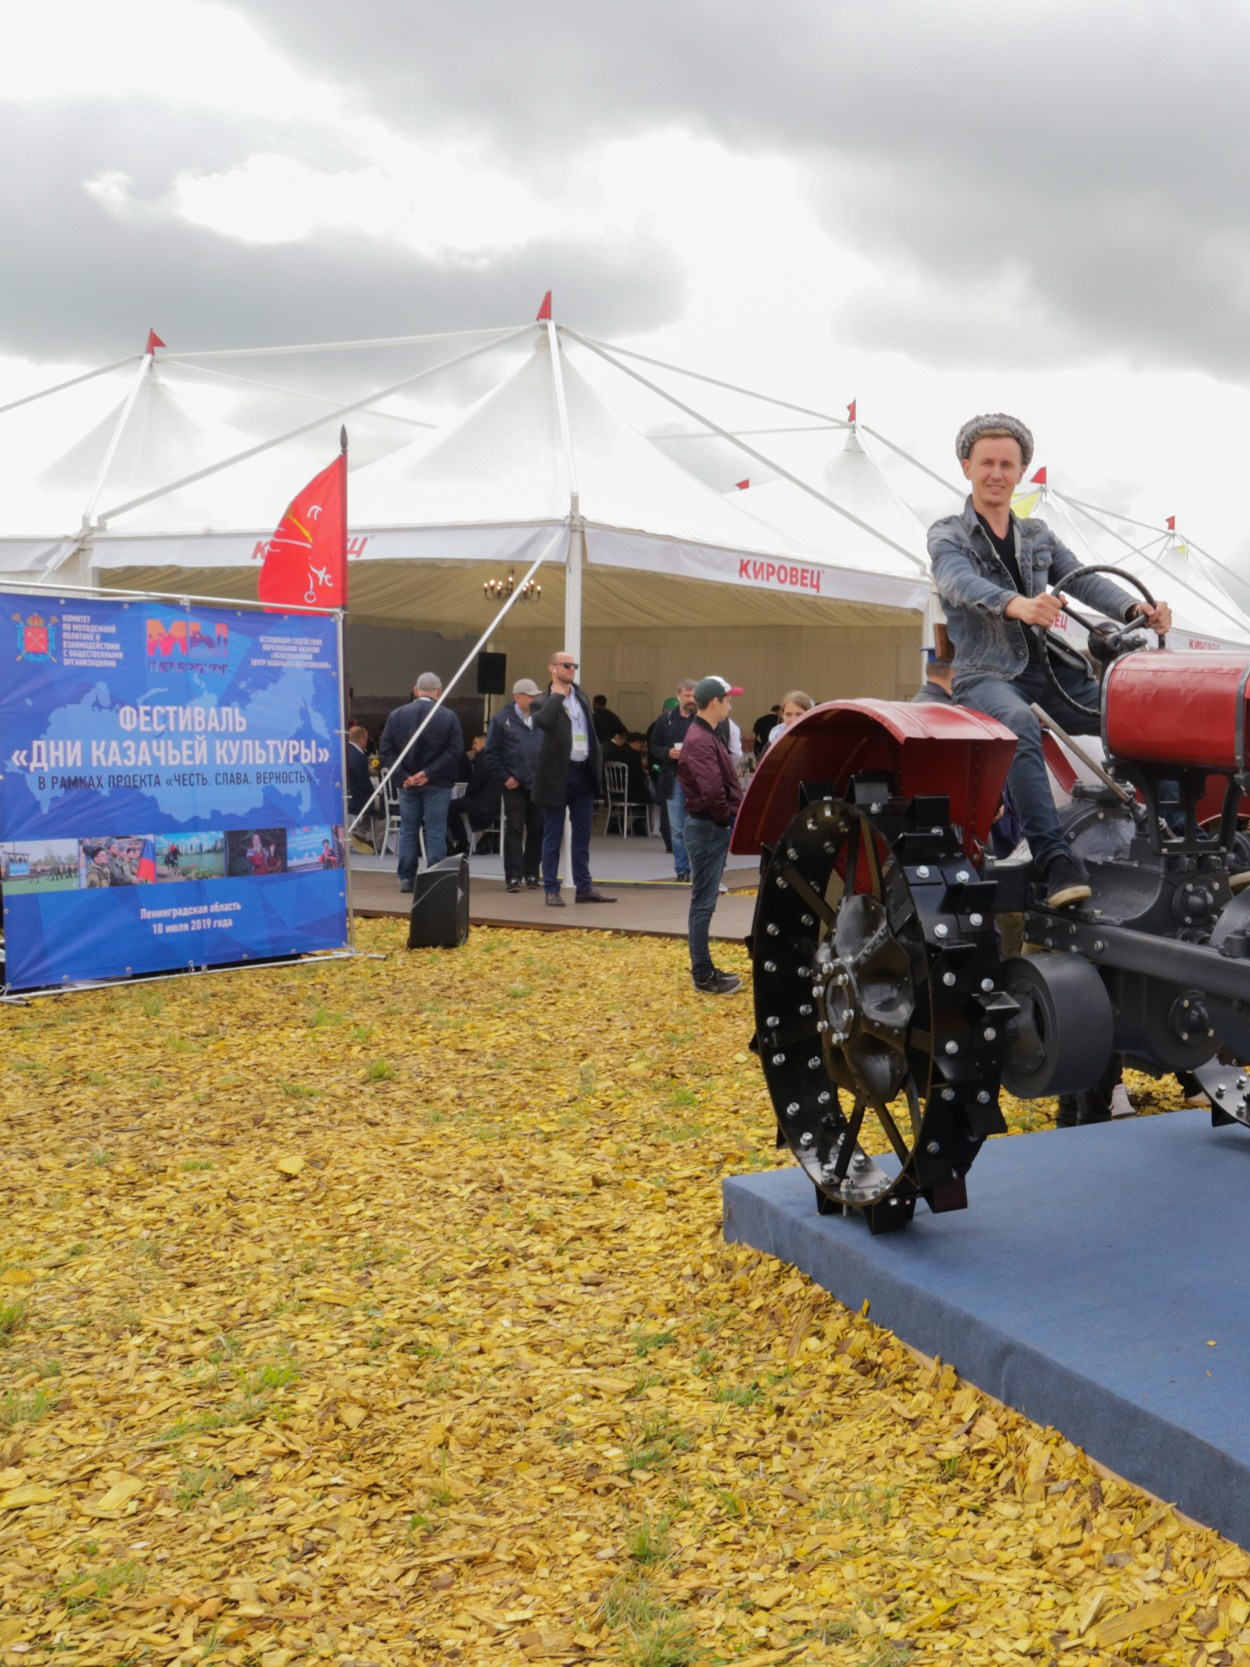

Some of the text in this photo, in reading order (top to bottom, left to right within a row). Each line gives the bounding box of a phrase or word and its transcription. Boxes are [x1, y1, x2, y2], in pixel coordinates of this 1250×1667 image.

[738, 558, 821, 593] КИРОВЕЦ
[118, 705, 247, 733] ФЕСТИВАЛЬ
[11, 735, 330, 772] «ДНИ КАЗАЧЬЕЙ КУЛЬТУРЫ»
[38, 776, 46, 790] В
[51, 775, 104, 790] РАМКАХ
[108, 774, 161, 788] ПРОЕКТА
[256, 771, 313, 784] ВЕРНОСТЬ»
[140, 901, 242, 919] Ленинградская область
[152, 918, 233, 935] 10 июля 2019 года
